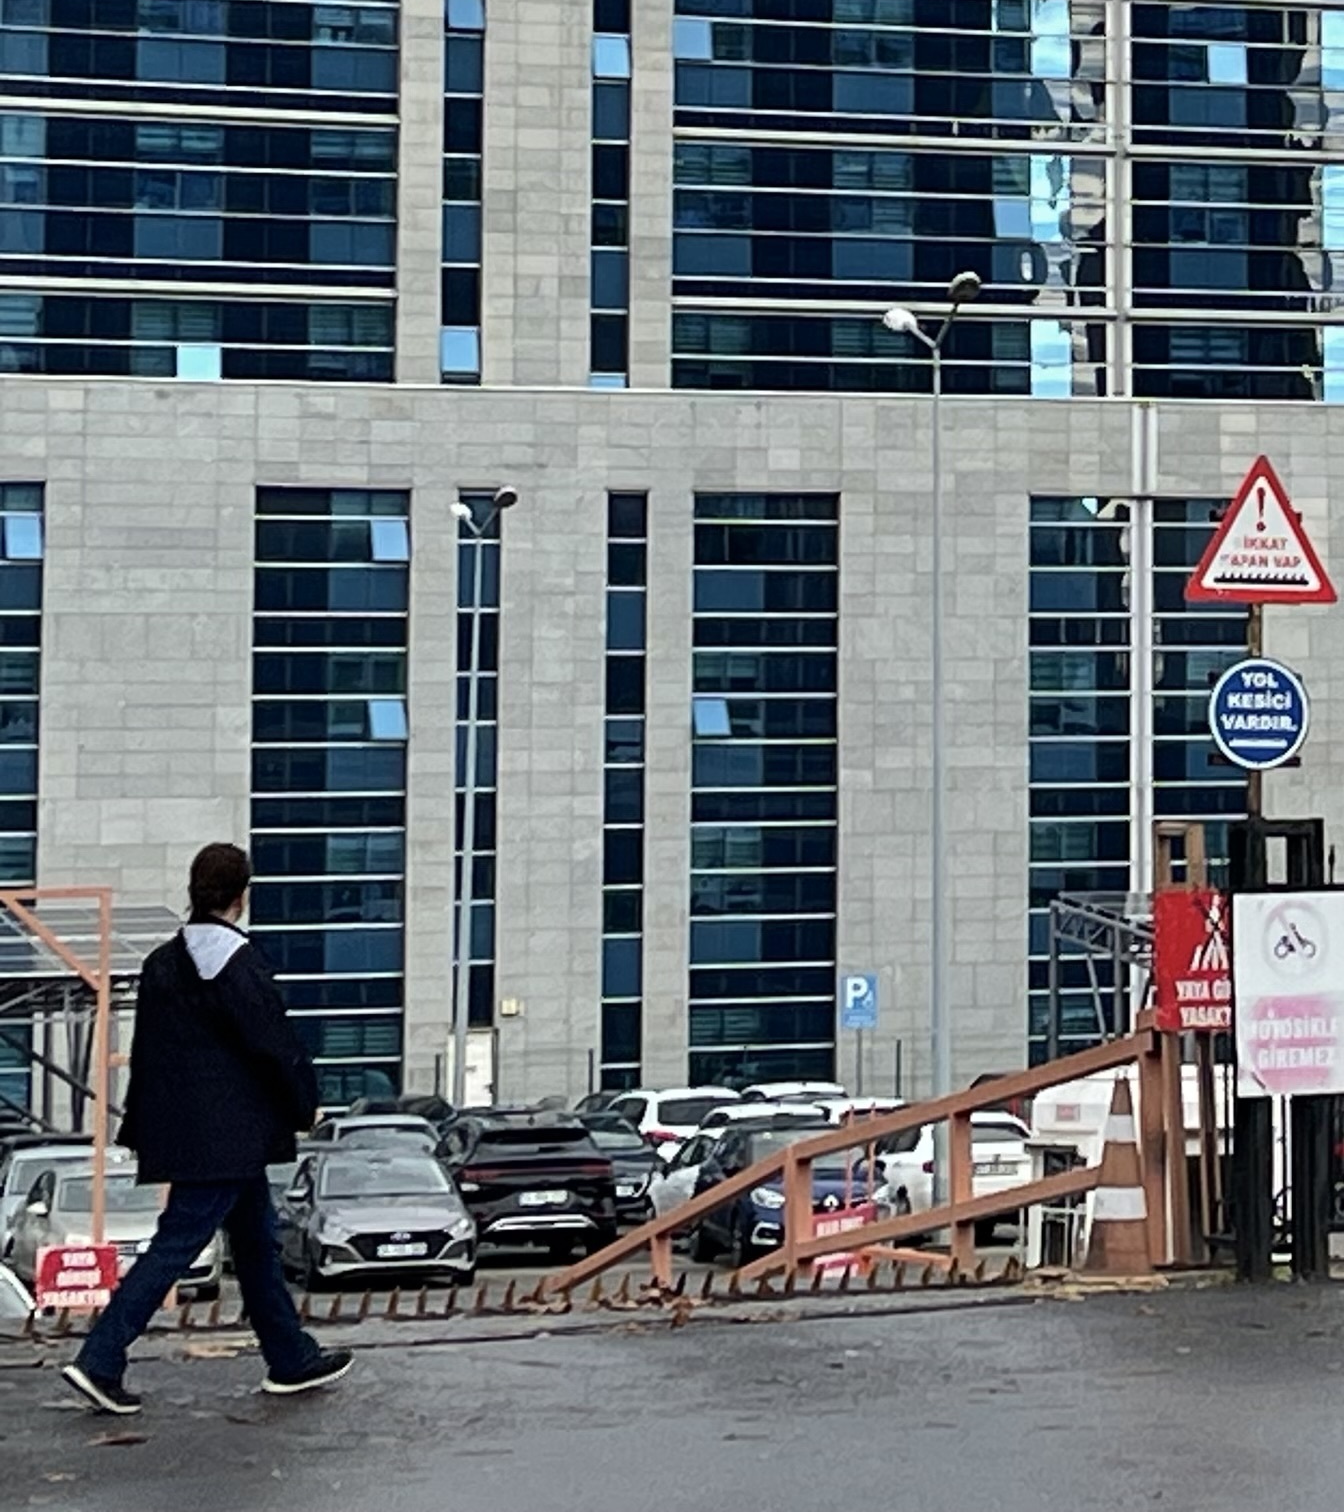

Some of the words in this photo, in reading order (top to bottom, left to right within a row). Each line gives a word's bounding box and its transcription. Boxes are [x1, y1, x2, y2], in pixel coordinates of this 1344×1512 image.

[1241, 672, 1279, 688] YOL
[1227, 690, 1293, 710] KESİCİ
[846, 977, 868, 1008] P
